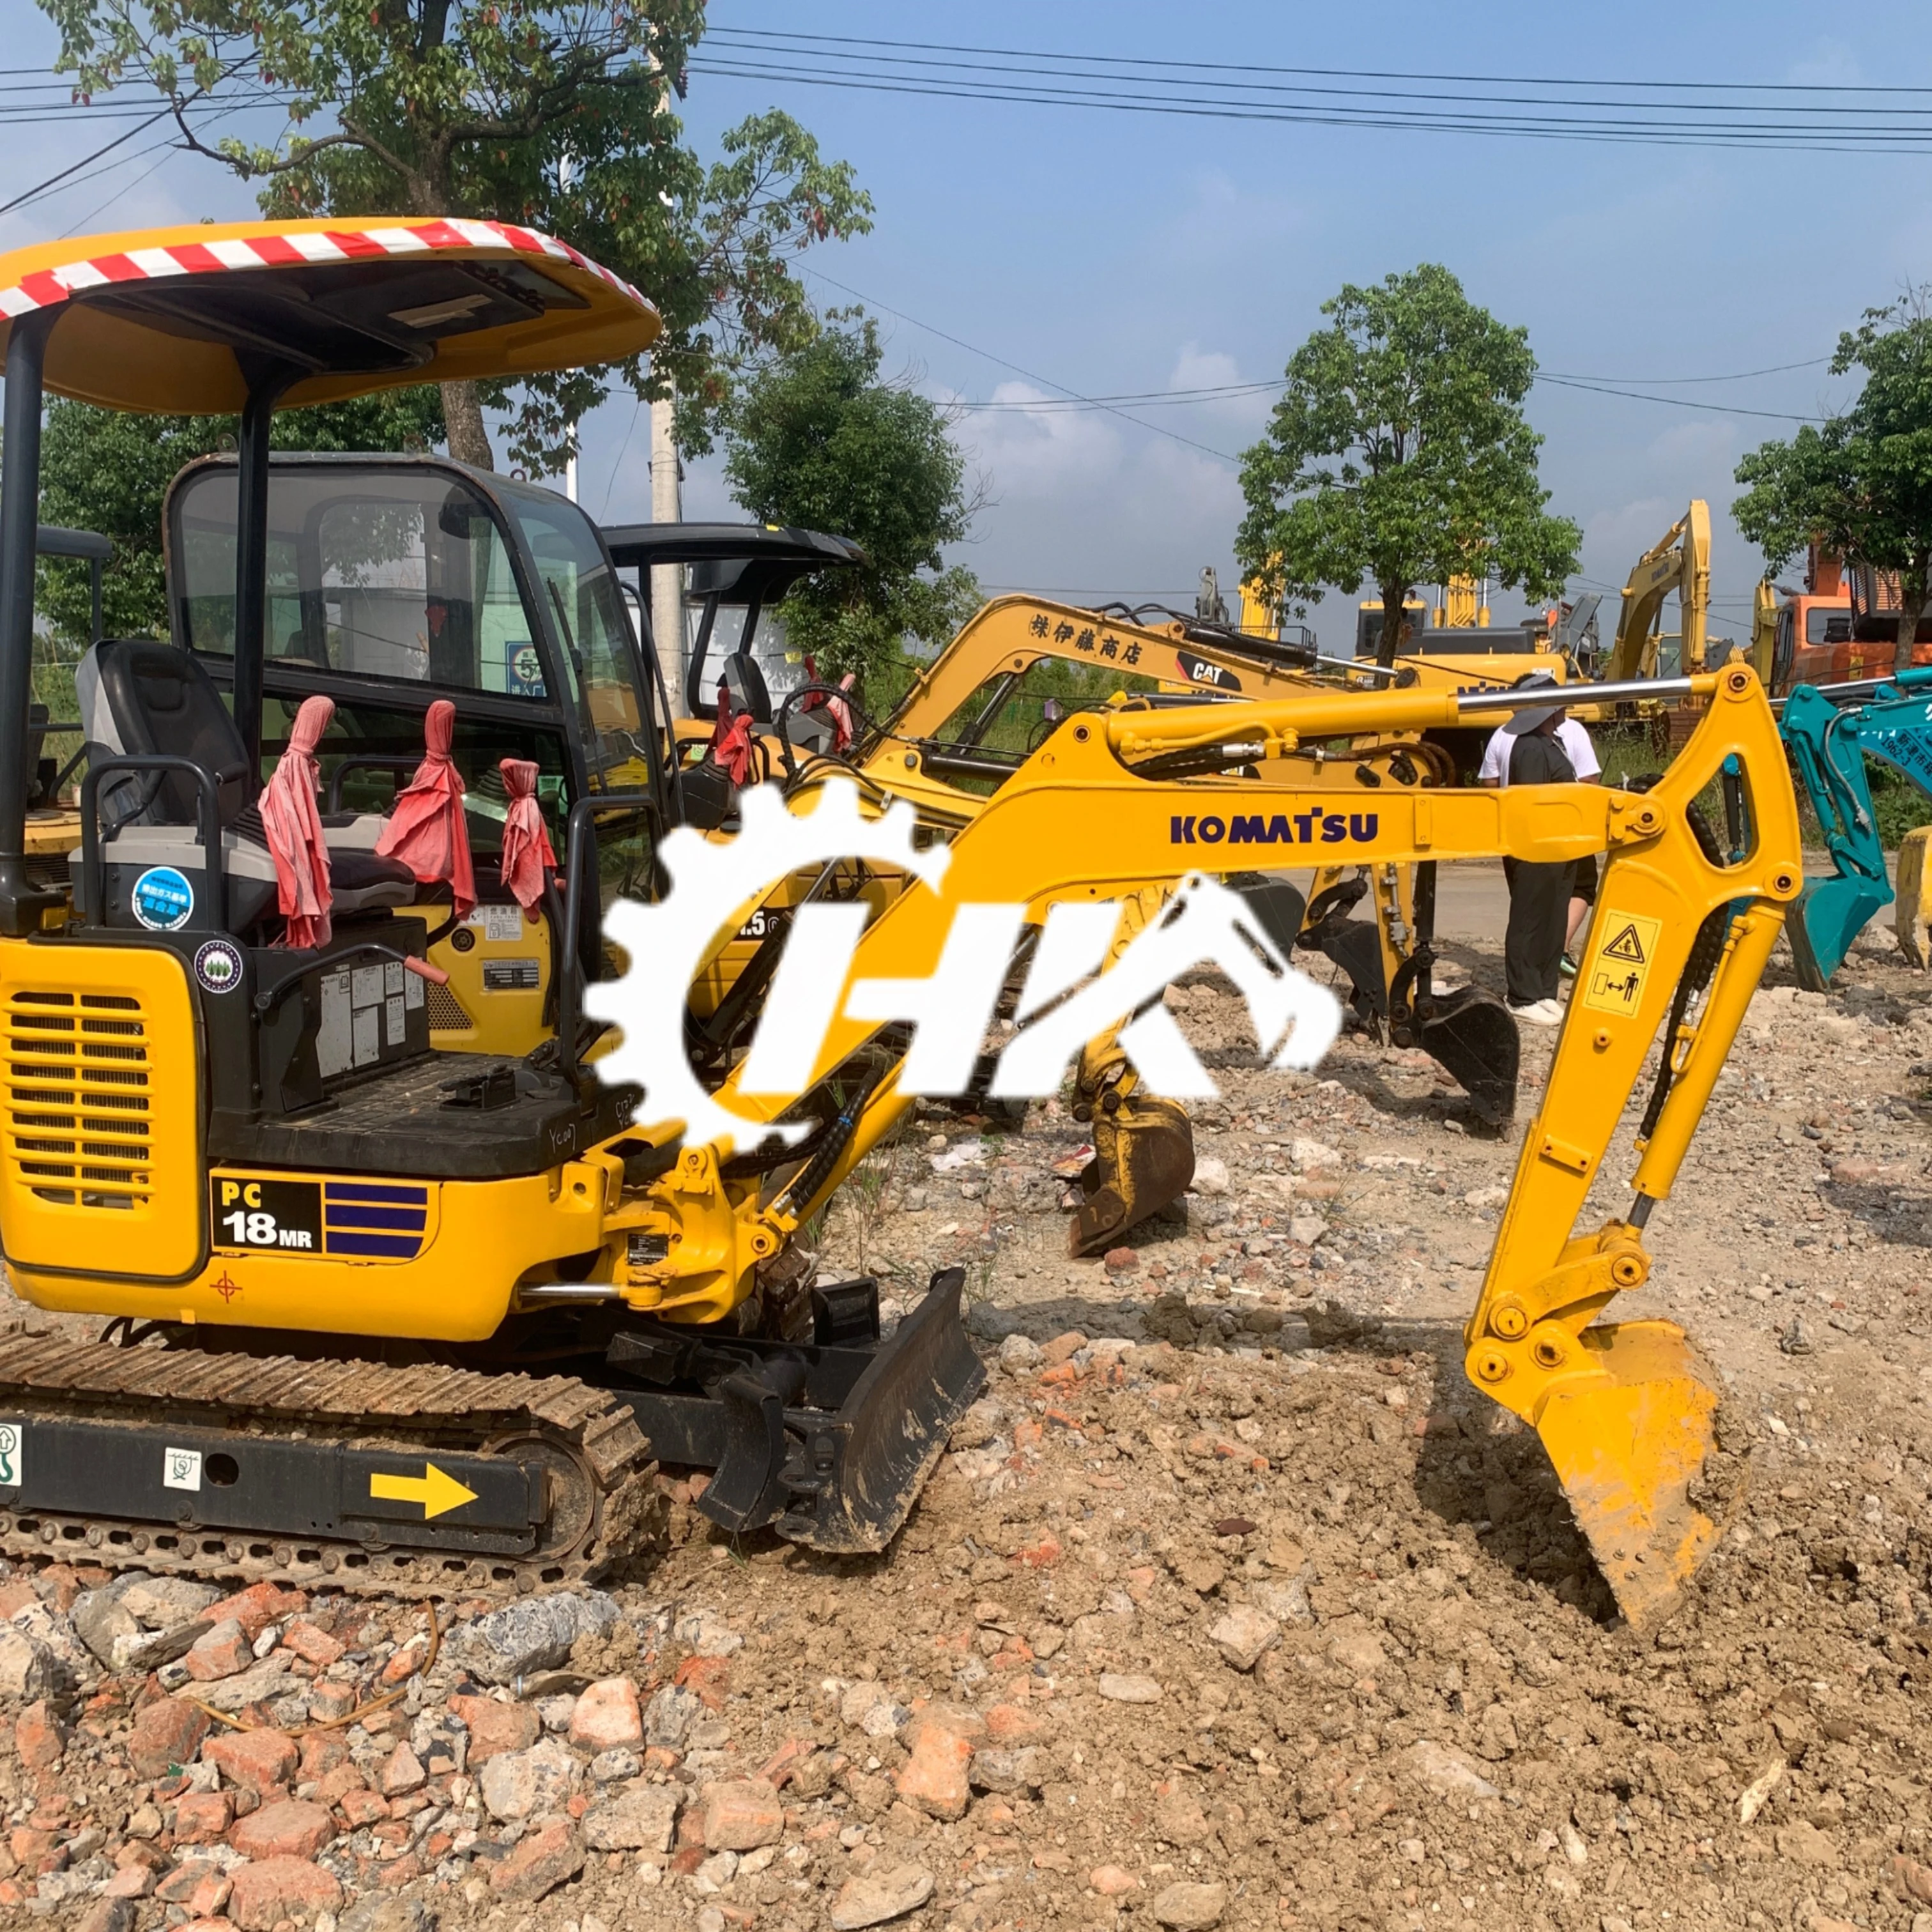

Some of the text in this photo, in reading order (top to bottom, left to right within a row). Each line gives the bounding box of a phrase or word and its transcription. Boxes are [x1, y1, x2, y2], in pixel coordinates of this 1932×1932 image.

[1193, 662, 1223, 684] CAT
[1170, 806, 1379, 844] KOMATSU
[222, 1181, 261, 1208] PC
